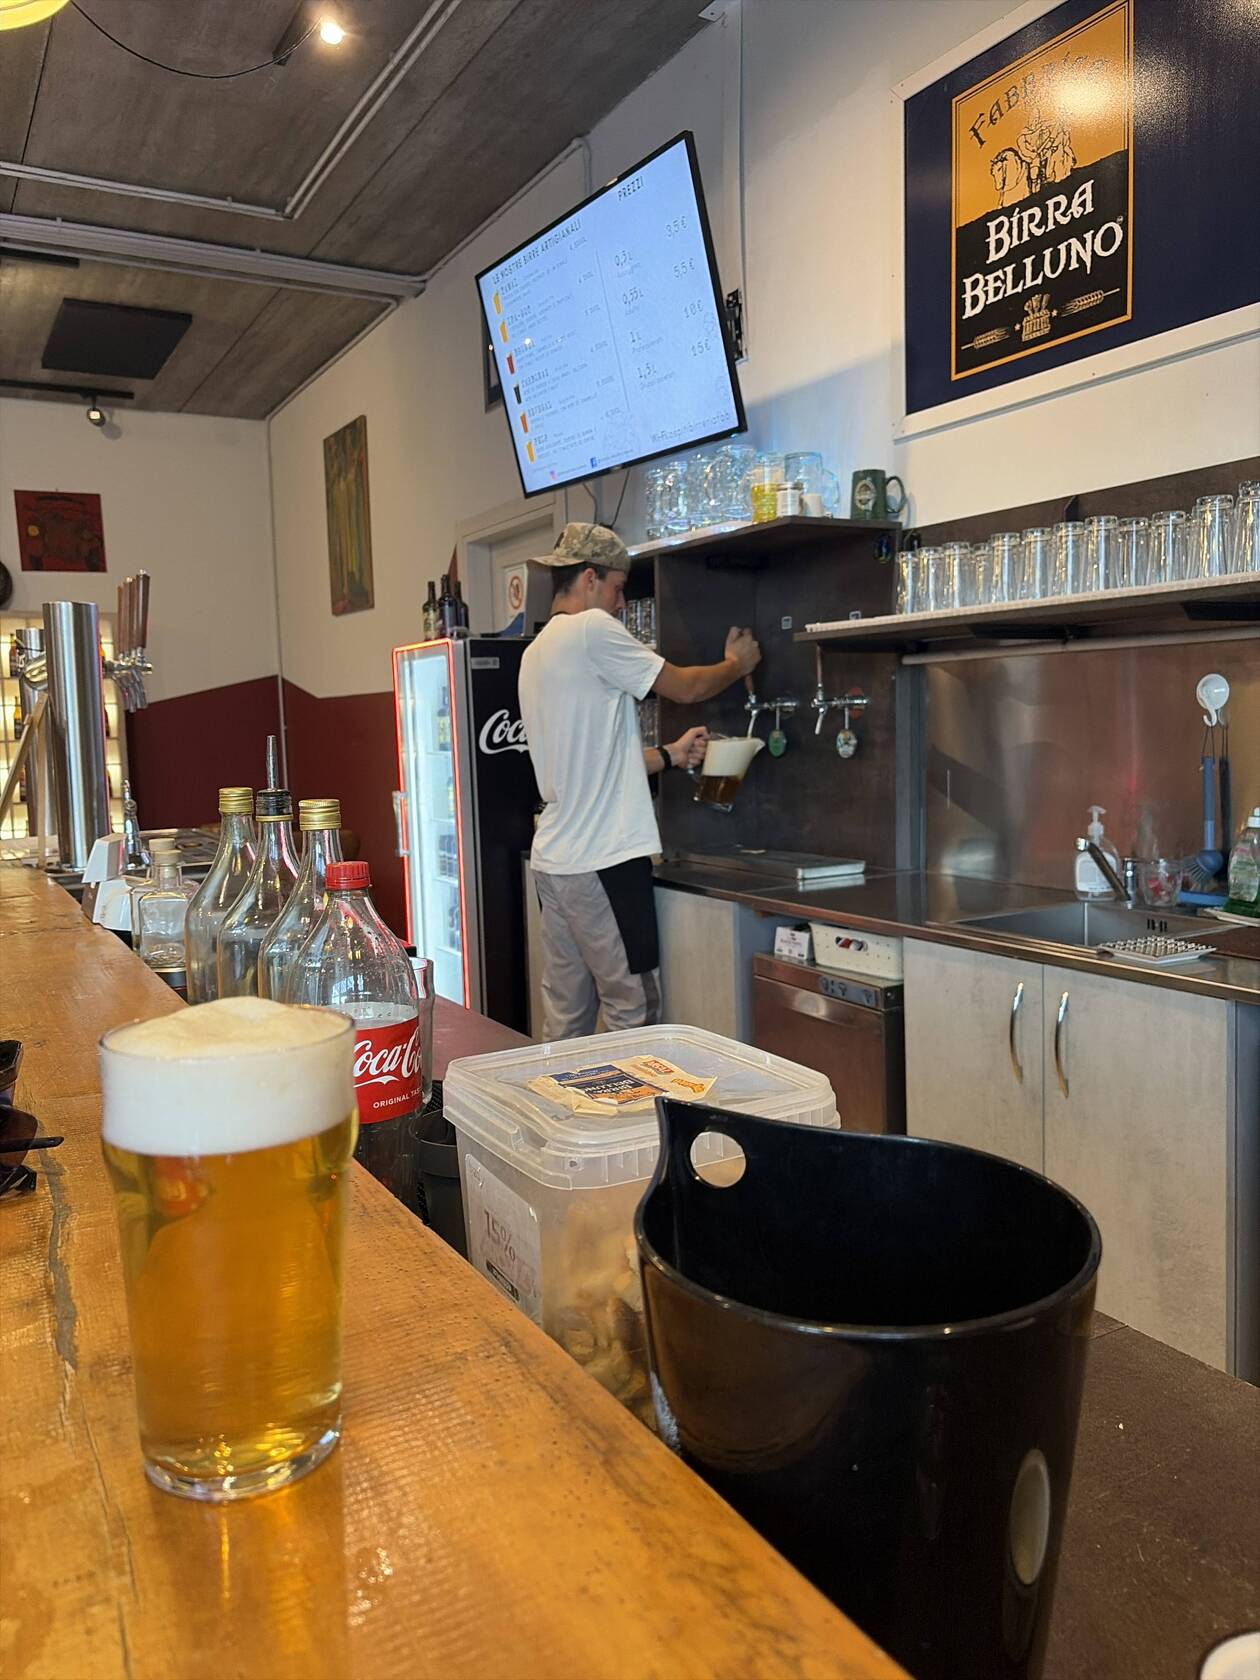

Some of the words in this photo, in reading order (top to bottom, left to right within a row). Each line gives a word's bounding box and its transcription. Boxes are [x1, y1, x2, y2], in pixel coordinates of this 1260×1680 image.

[618, 176, 644, 201] PREZZI
[962, 220, 1123, 320] BELLUNO
[372, 1094, 410, 1109] ORIGINAL
[484, 1209, 516, 1262] 15%
